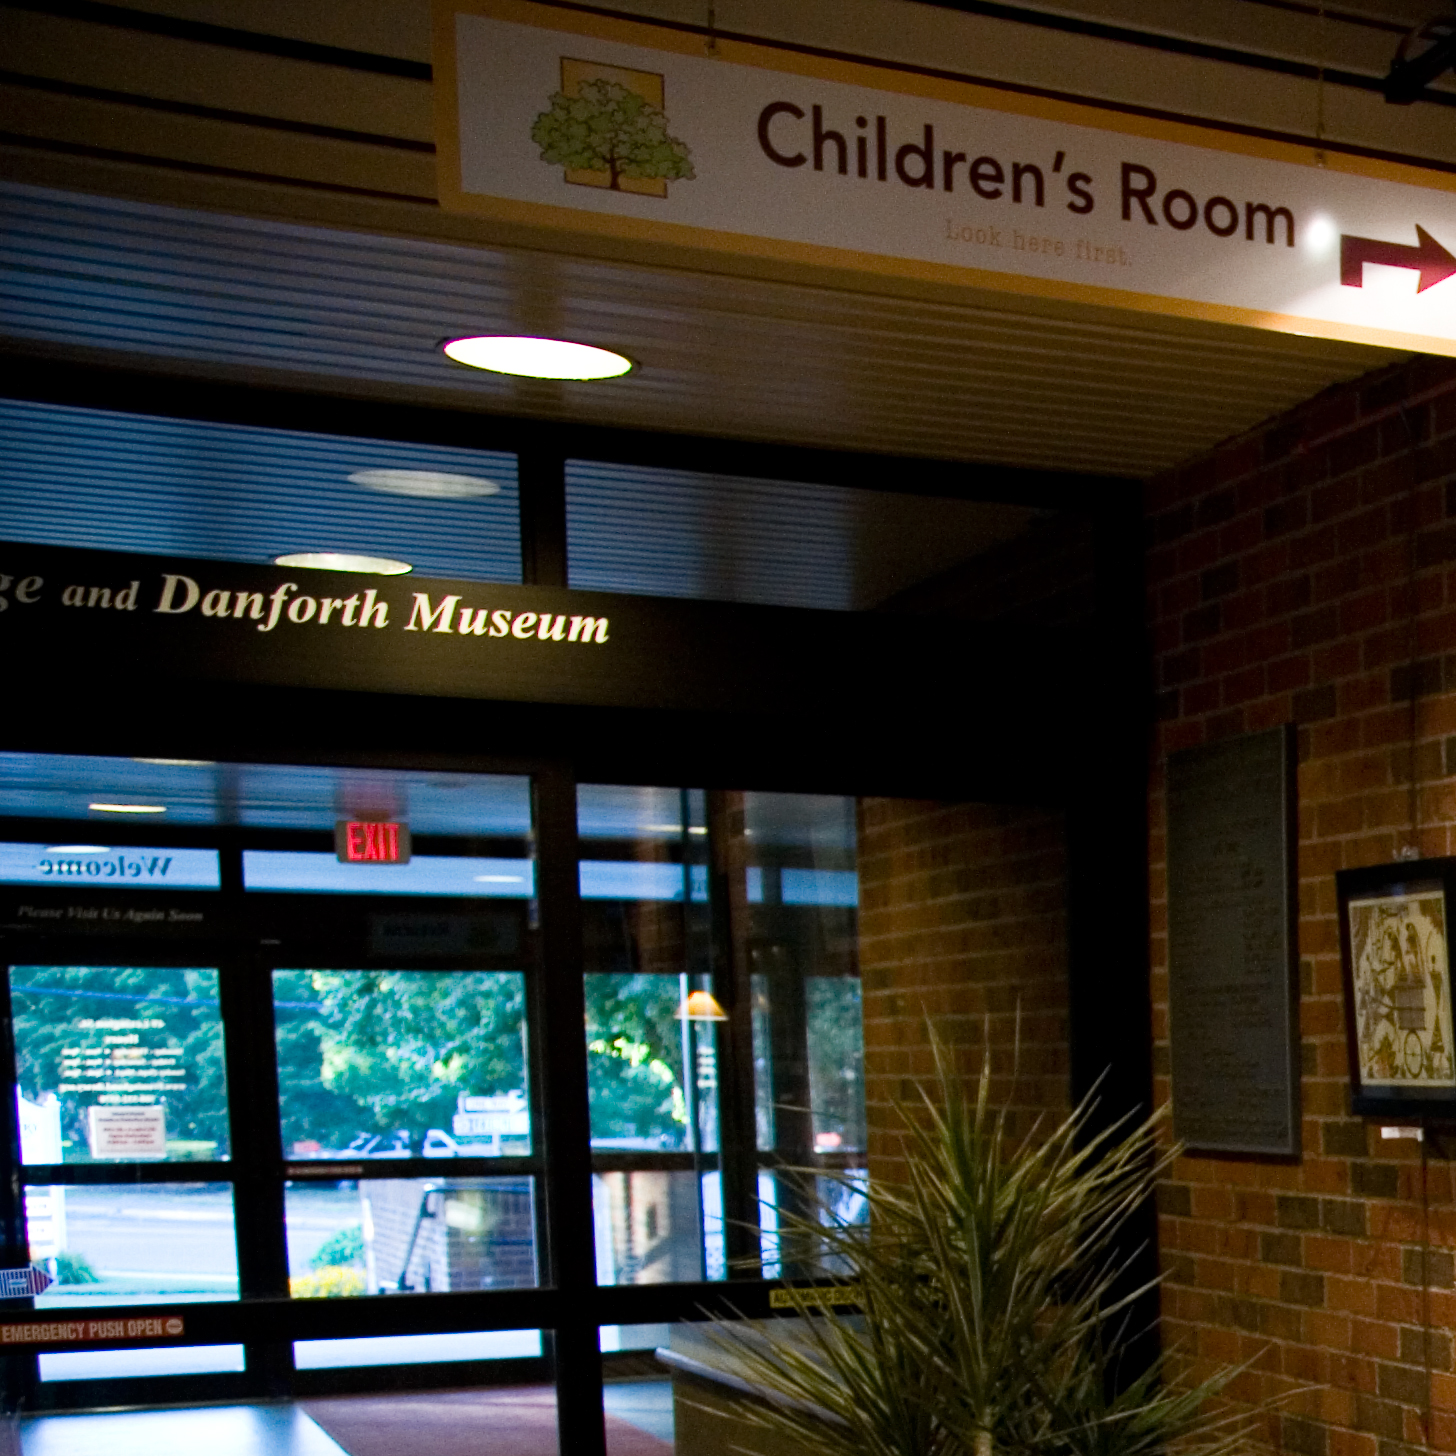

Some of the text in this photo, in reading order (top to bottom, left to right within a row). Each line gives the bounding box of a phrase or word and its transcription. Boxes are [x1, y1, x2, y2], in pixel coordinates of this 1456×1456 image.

[756, 99, 1296, 249] Children's Room
[944, 218, 1133, 267] Look here first.
[61, 580, 141, 611] and
[153, 573, 390, 631] Danforth
[404, 592, 611, 645] Museum
[346, 821, 400, 861] EXIT
[1, 1319, 163, 1343] EMERGENCY PUSH OPEN
